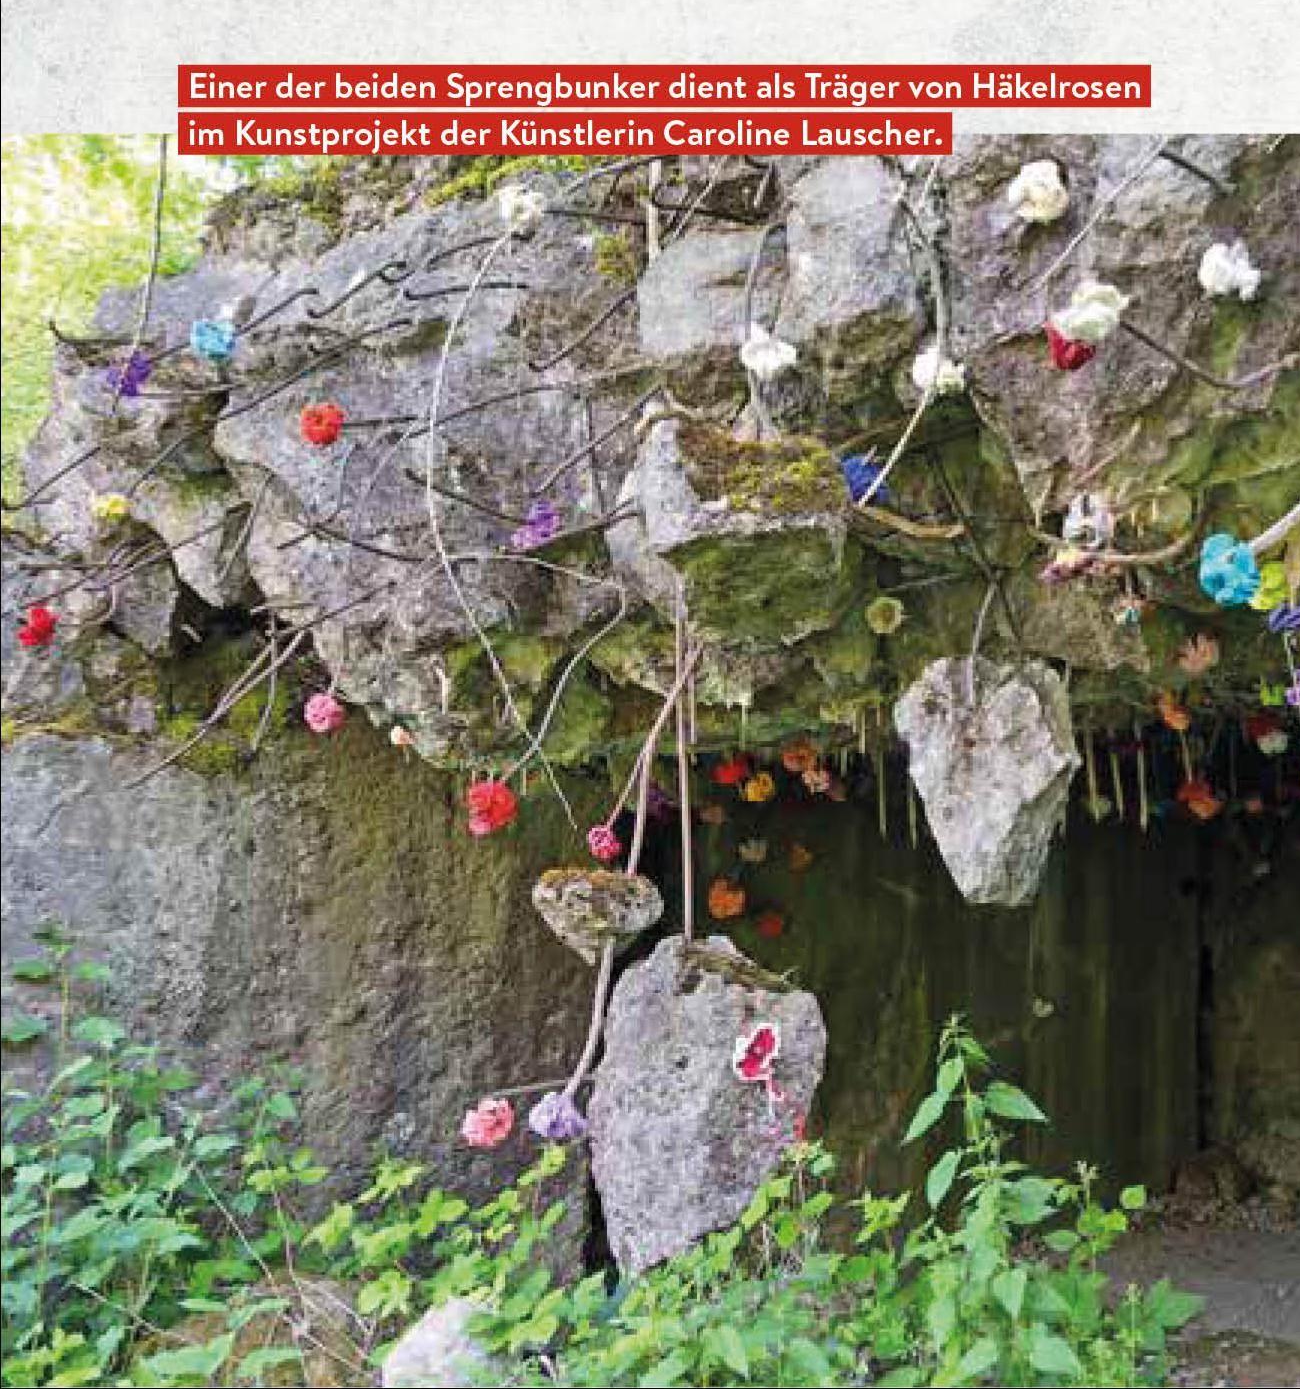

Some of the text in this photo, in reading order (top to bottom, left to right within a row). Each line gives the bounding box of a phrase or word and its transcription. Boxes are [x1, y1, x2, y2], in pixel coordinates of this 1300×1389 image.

[191, 73, 1140, 105] Einer der beiden Sprengbunker dient als Träger von Häkelrosen
[190, 120, 942, 152] im Kunstprojekt der Künstlerin Caroline Lauscher.
